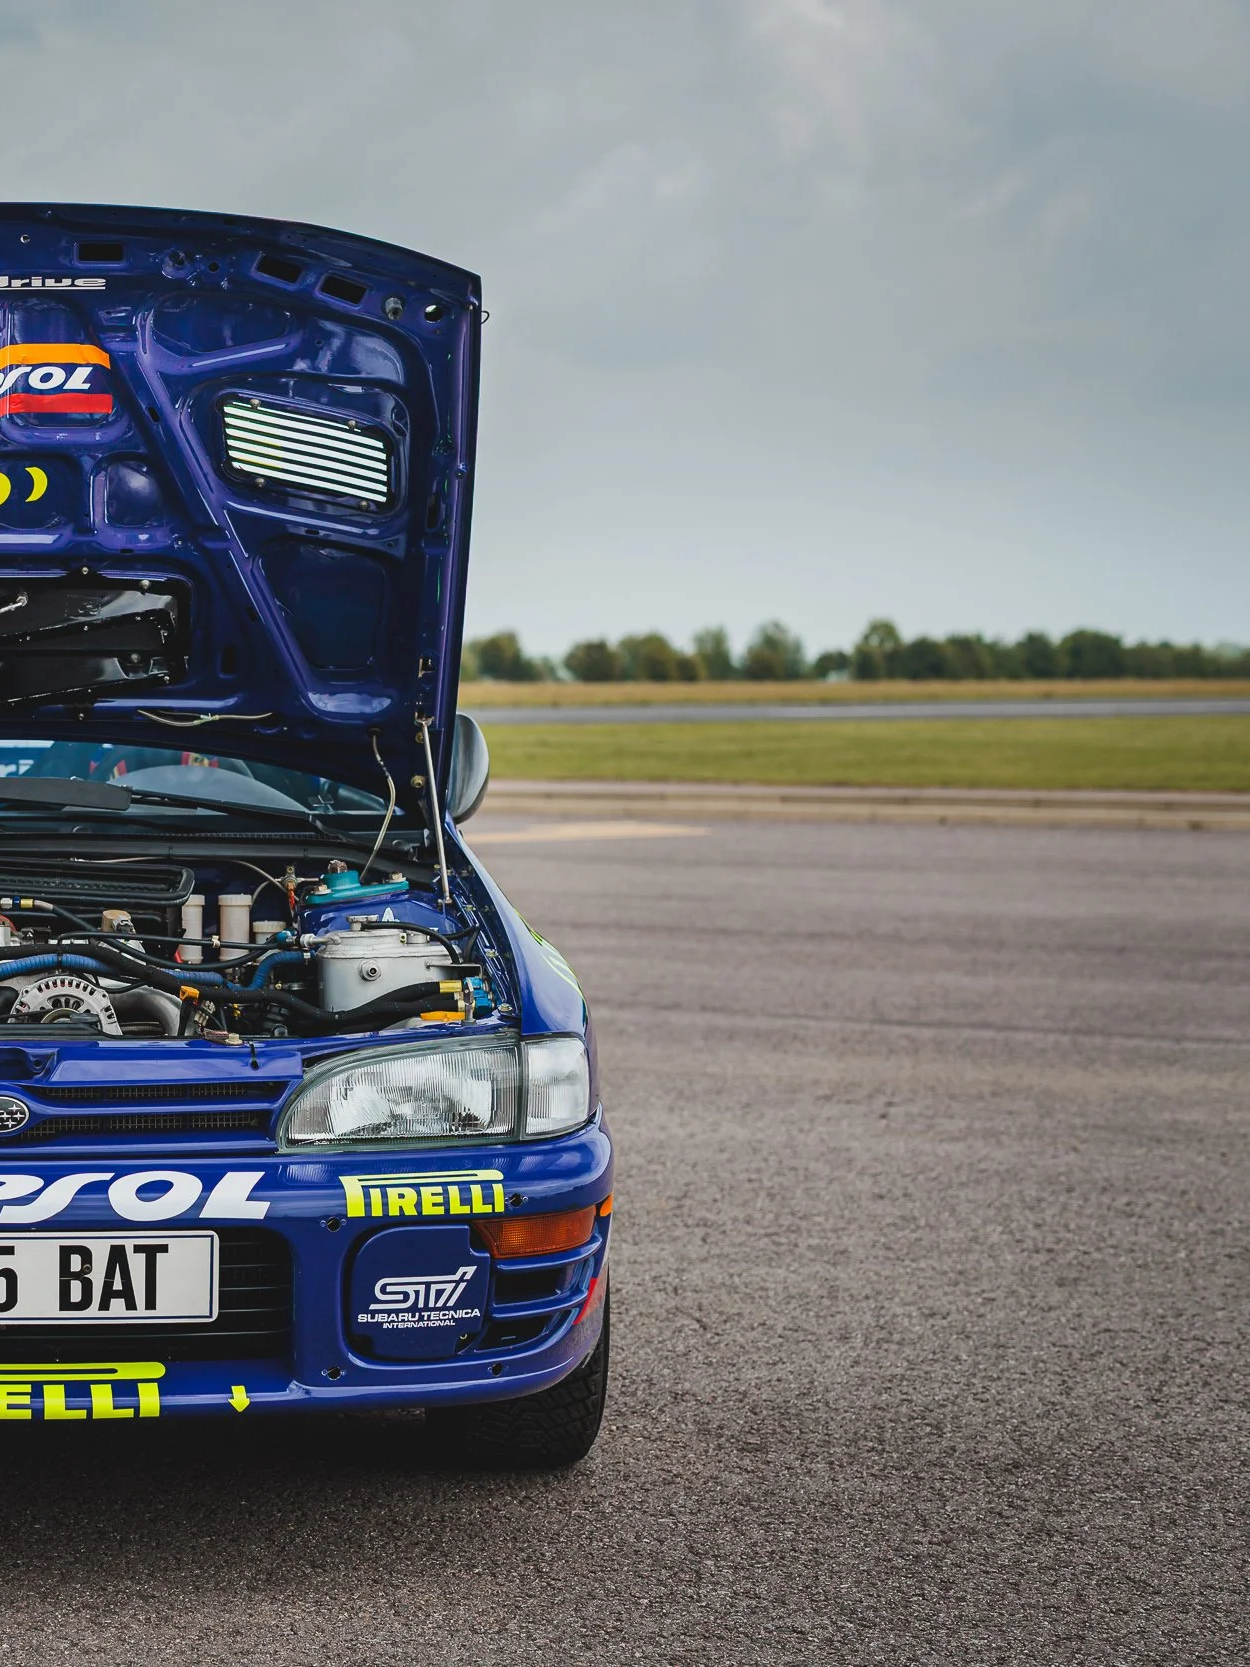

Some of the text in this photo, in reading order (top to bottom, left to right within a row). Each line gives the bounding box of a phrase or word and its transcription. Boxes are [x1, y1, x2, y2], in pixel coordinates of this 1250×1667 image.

[338, 1169, 505, 1217] PIRELLI
[58, 1244, 169, 1312] BAT
[357, 1308, 481, 1323] SUBARU TECNICA
[382, 1319, 456, 1329] INTERNATIONAL
